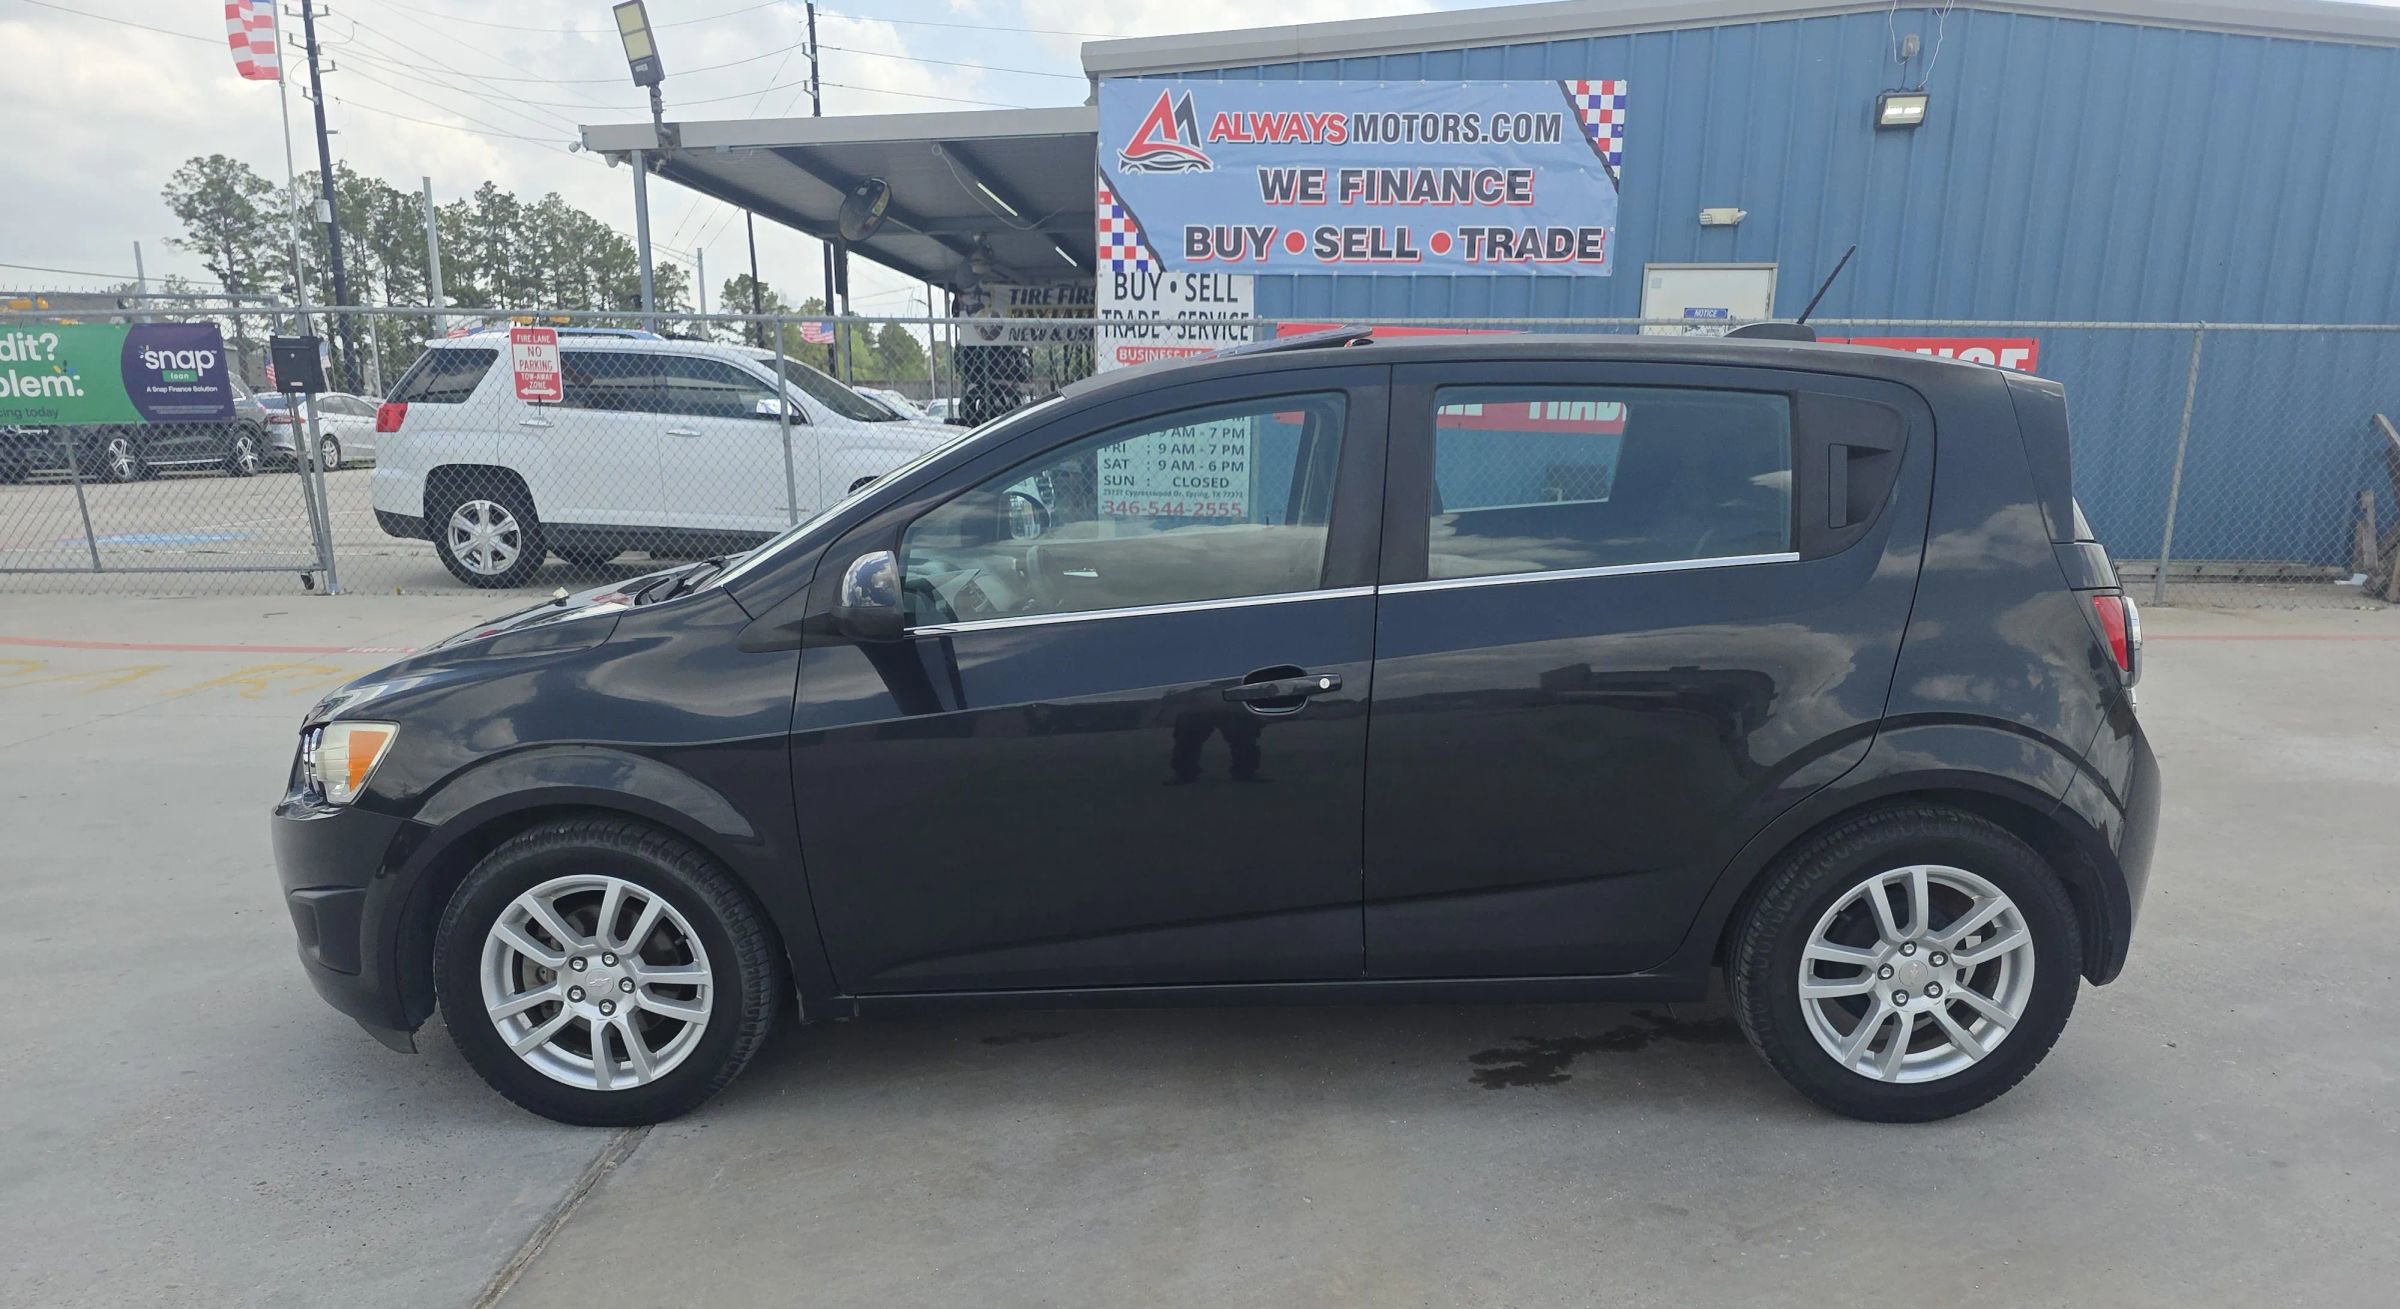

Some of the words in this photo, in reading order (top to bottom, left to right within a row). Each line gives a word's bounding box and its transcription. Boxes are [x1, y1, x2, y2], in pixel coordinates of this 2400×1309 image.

[1258, 167, 1325, 205] WE
[1338, 167, 1535, 205] FINANCE
[1184, 225, 1277, 262] BUY
[1312, 226, 1421, 263] SELL
[1457, 227, 1605, 264] TRADE
[1114, 272, 1163, 301] BUY
[1185, 273, 1238, 303] SELL
[1009, 288, 1053, 305] TIRE
[1102, 309, 1160, 339] TRADE
[1177, 311, 1249, 341] SERVICE
[1008, 327, 1047, 341] NEW
[527, 346, 542, 357] NO
[145, 350, 215, 376] snap
[519, 360, 553, 371] PARKING
[25, 408, 58, 419] today
[1171, 427, 1195, 438] AM
[1209, 427, 1217, 438] 7
[1222, 428, 1245, 439] PM
[1158, 443, 1167, 454] 9
[1171, 444, 1195, 455] AM
[1209, 444, 1217, 455] 7
[1222, 444, 1245, 455] PM
[1104, 459, 1129, 470] SAT
[1158, 460, 1167, 471] 9
[1171, 460, 1195, 471] AM
[1208, 461, 1217, 472] 6
[1222, 461, 1244, 472] PM
[1104, 475, 1135, 486] SUN
[1172, 477, 1229, 488] CLOSED
[1103, 500, 1242, 517] 346-544-2555
